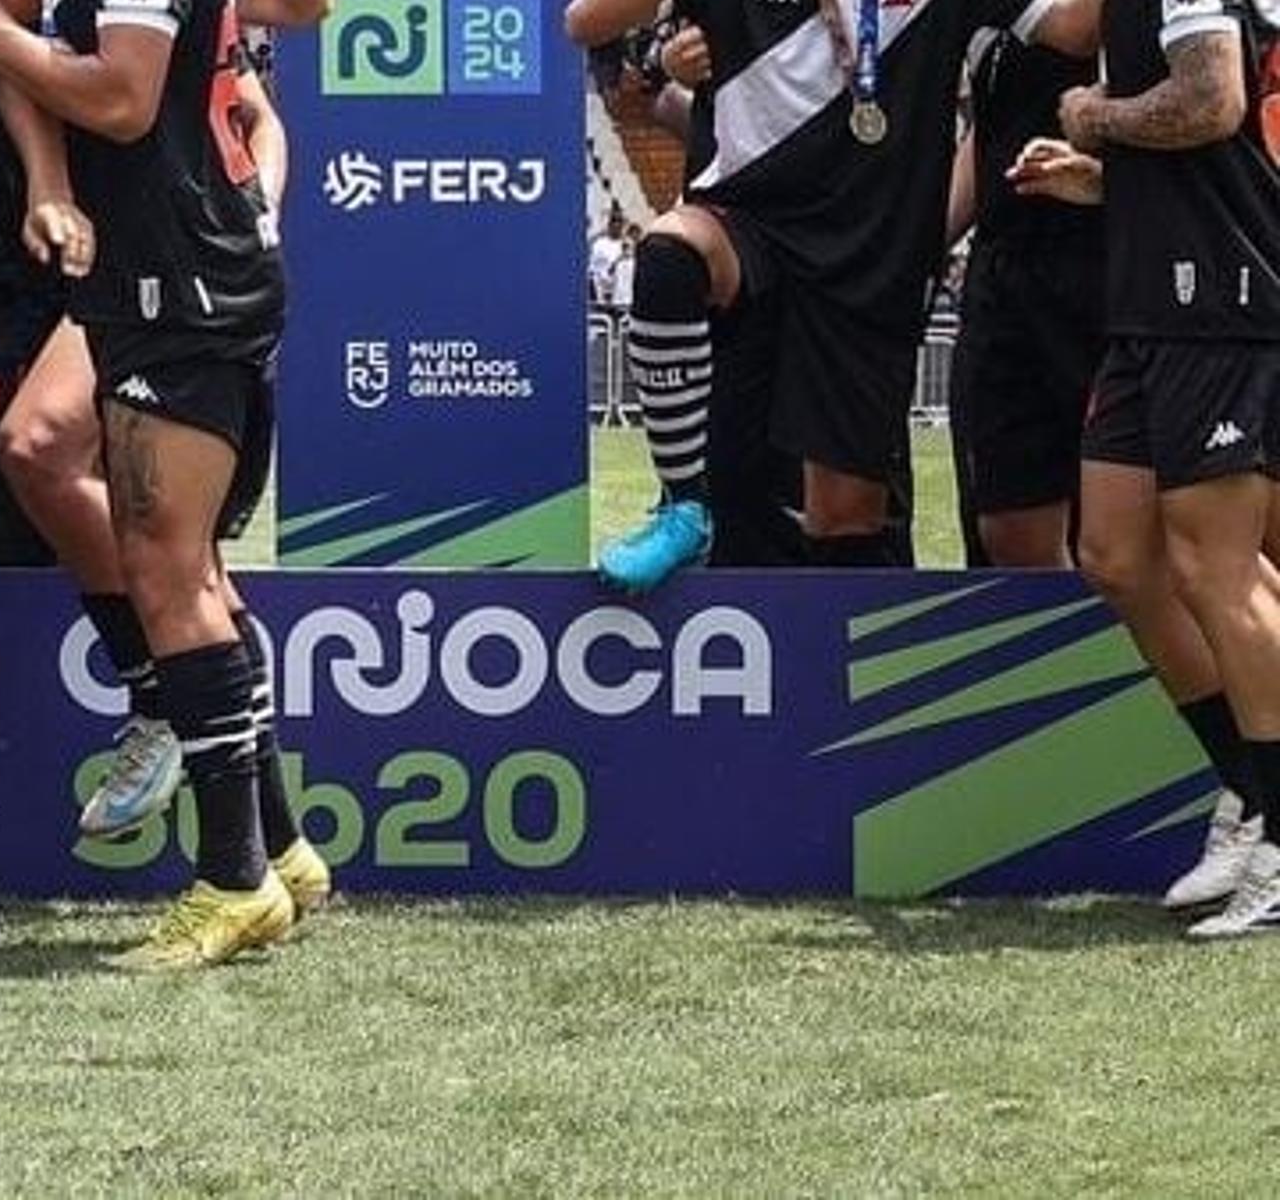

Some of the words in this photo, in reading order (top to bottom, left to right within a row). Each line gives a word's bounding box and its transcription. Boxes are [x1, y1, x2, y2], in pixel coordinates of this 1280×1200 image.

[464, 6, 525, 42] 20
[464, 47, 526, 81] 24
[393, 160, 545, 202] FERJ
[408, 341, 477, 359] MUITO
[408, 358, 470, 377] ALÉM
[473, 360, 518, 377] DOS
[408, 380, 533, 397] GRAMADOS
